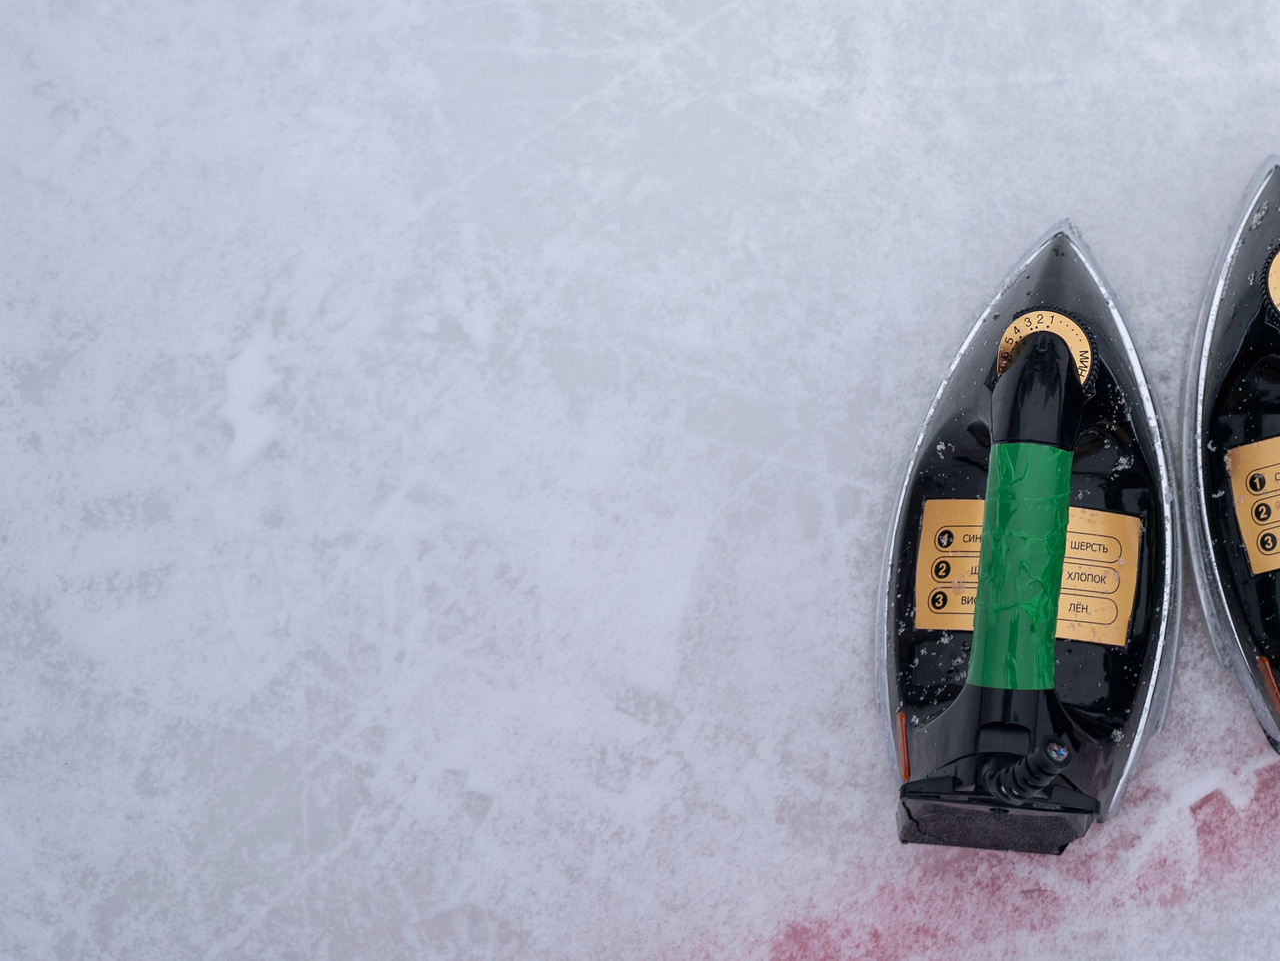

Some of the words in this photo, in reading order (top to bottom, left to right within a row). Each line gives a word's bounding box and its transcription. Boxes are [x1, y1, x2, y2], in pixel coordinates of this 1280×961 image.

[1004, 337, 1014, 346] 5
[1013, 325, 1022, 335] 4
[1024, 317, 1032, 327] 3
[1036, 313, 1044, 324] 2
[1078, 350, 1089, 378] МИН
[1258, 506, 1267, 519] 2
[1070, 540, 1109, 553] ШЕРСТЬ
[1264, 536, 1273, 549] 3
[938, 563, 947, 576] 2
[1067, 571, 1107, 584] ХЛОПОК
[935, 593, 944, 607] 3
[1068, 602, 1088, 613] ЛЁН
